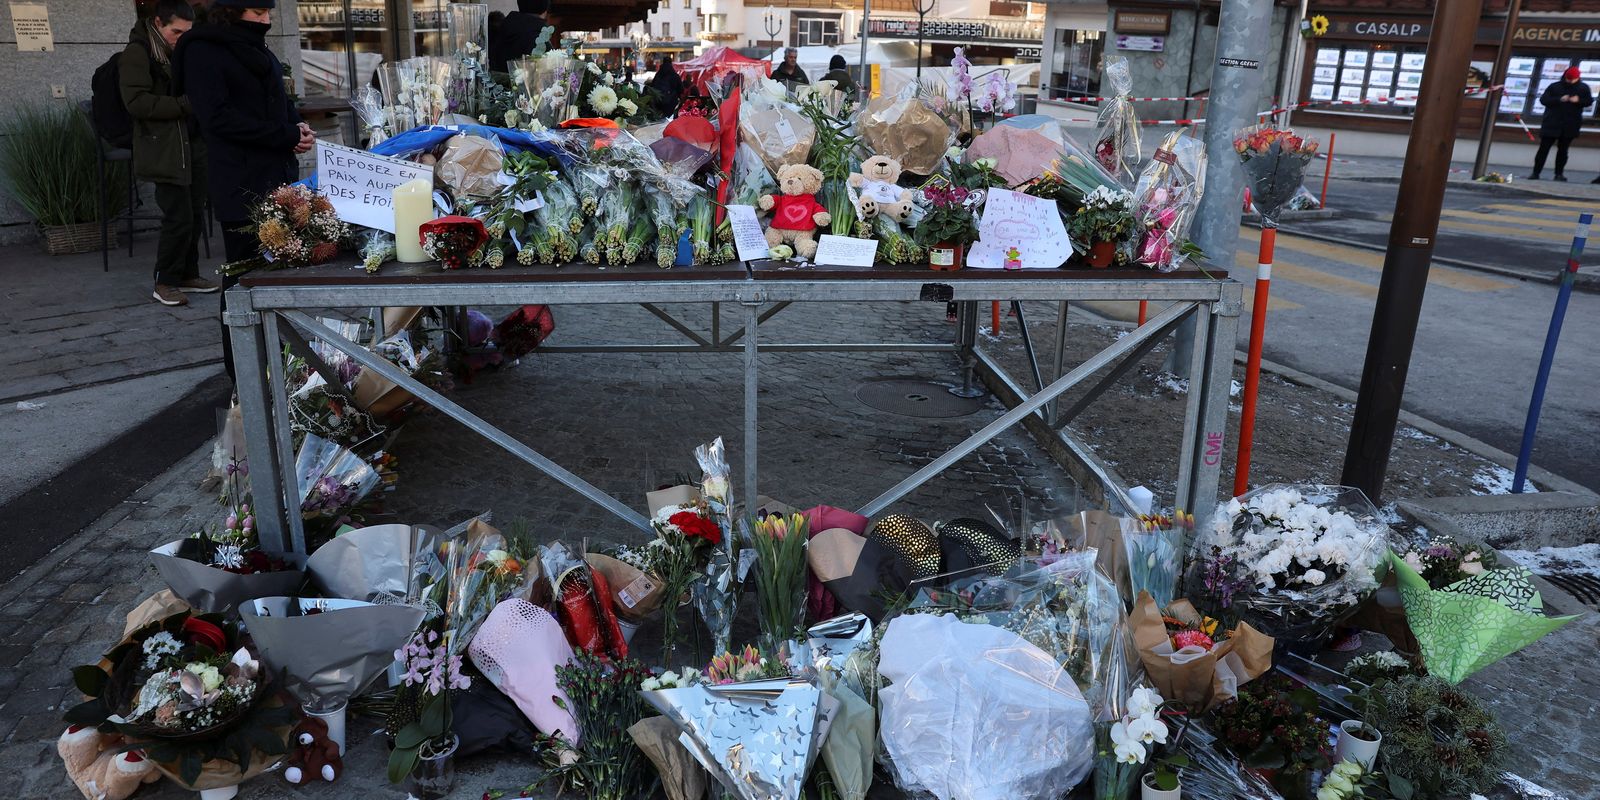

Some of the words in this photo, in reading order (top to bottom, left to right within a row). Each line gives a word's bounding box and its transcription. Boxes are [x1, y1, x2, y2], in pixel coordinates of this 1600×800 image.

[1355, 21, 1421, 36] CASALP
[1513, 27, 1583, 41] AGENCE
[324, 149, 394, 176] REPOSEZ
[399, 170, 417, 179] EN
[328, 169, 358, 184] PAIX
[330, 184, 356, 200] DES
[363, 190, 394, 209] ÉTOI
[1204, 431, 1223, 466] CME
